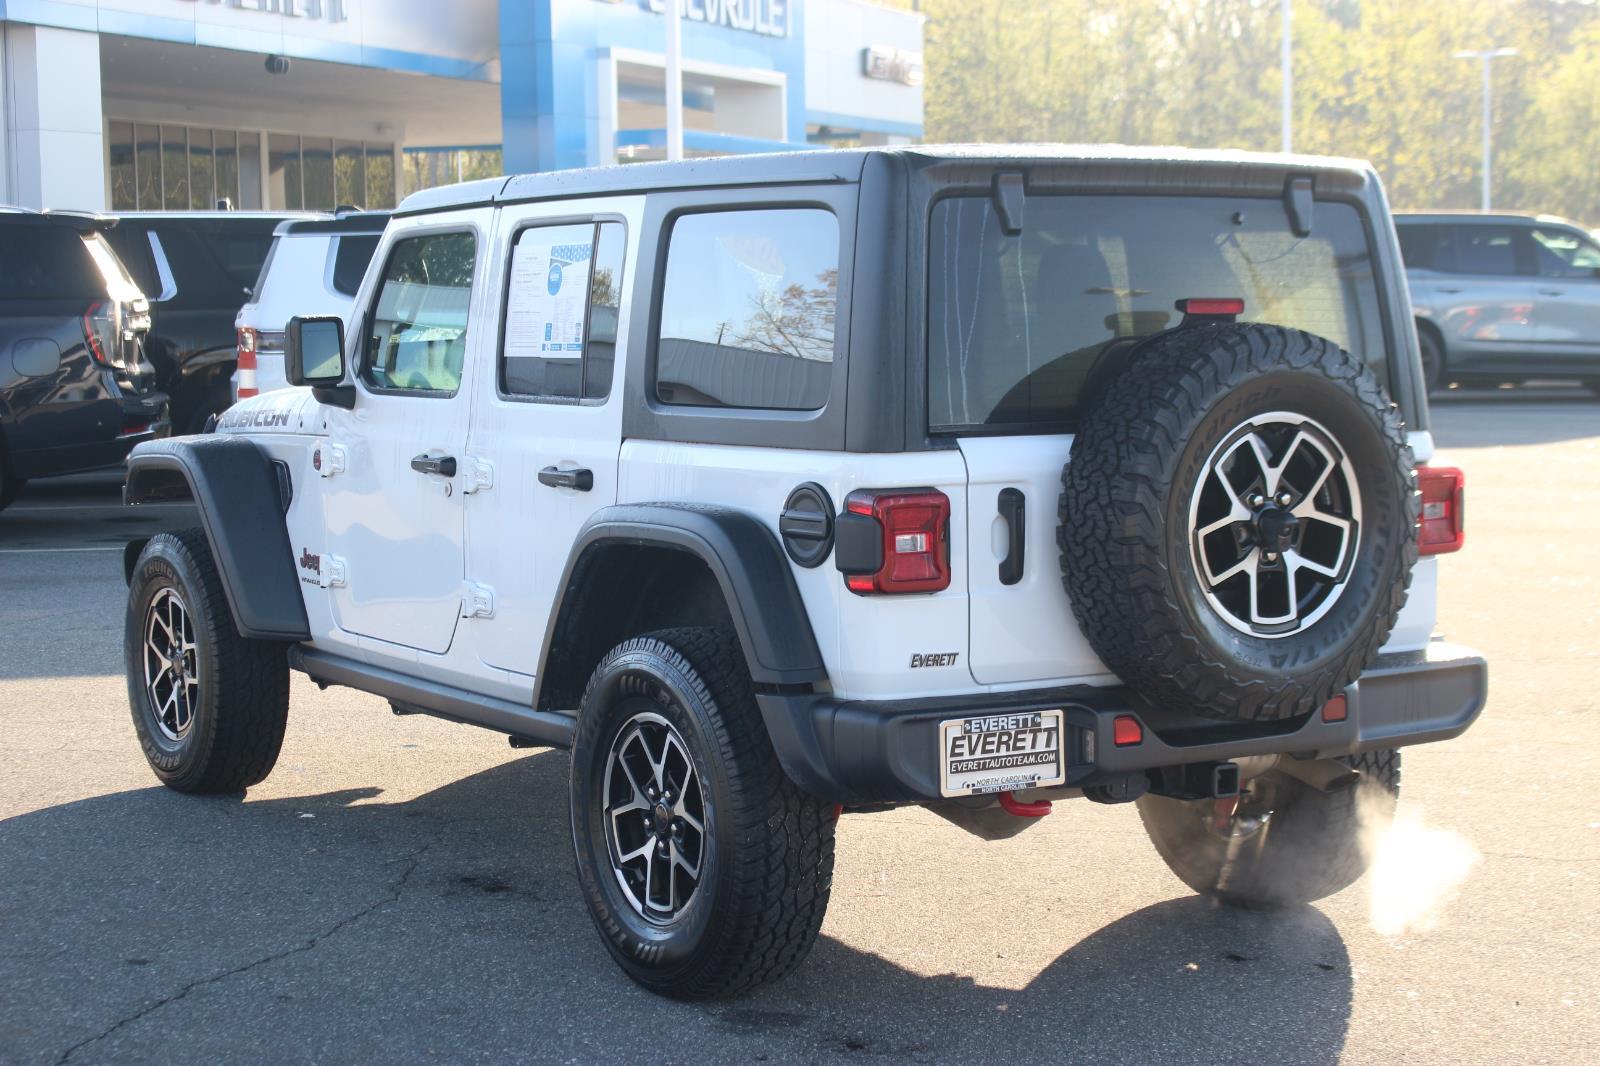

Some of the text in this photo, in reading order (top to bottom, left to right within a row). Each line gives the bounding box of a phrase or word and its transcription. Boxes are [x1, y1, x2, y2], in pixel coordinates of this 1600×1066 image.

[648, 0, 793, 39] VROLET
[220, 409, 291, 429] RUBICON
[911, 652, 959, 668] EVERETT
[971, 715, 1034, 733] EVERETT
[950, 727, 1057, 758] EVERETT
[951, 753, 1056, 773] EVERETTAUTOTEAM.COM
[976, 774, 1032, 786] NORTH CAROLINA
[1000, 783, 1027, 791] CAROLINA
